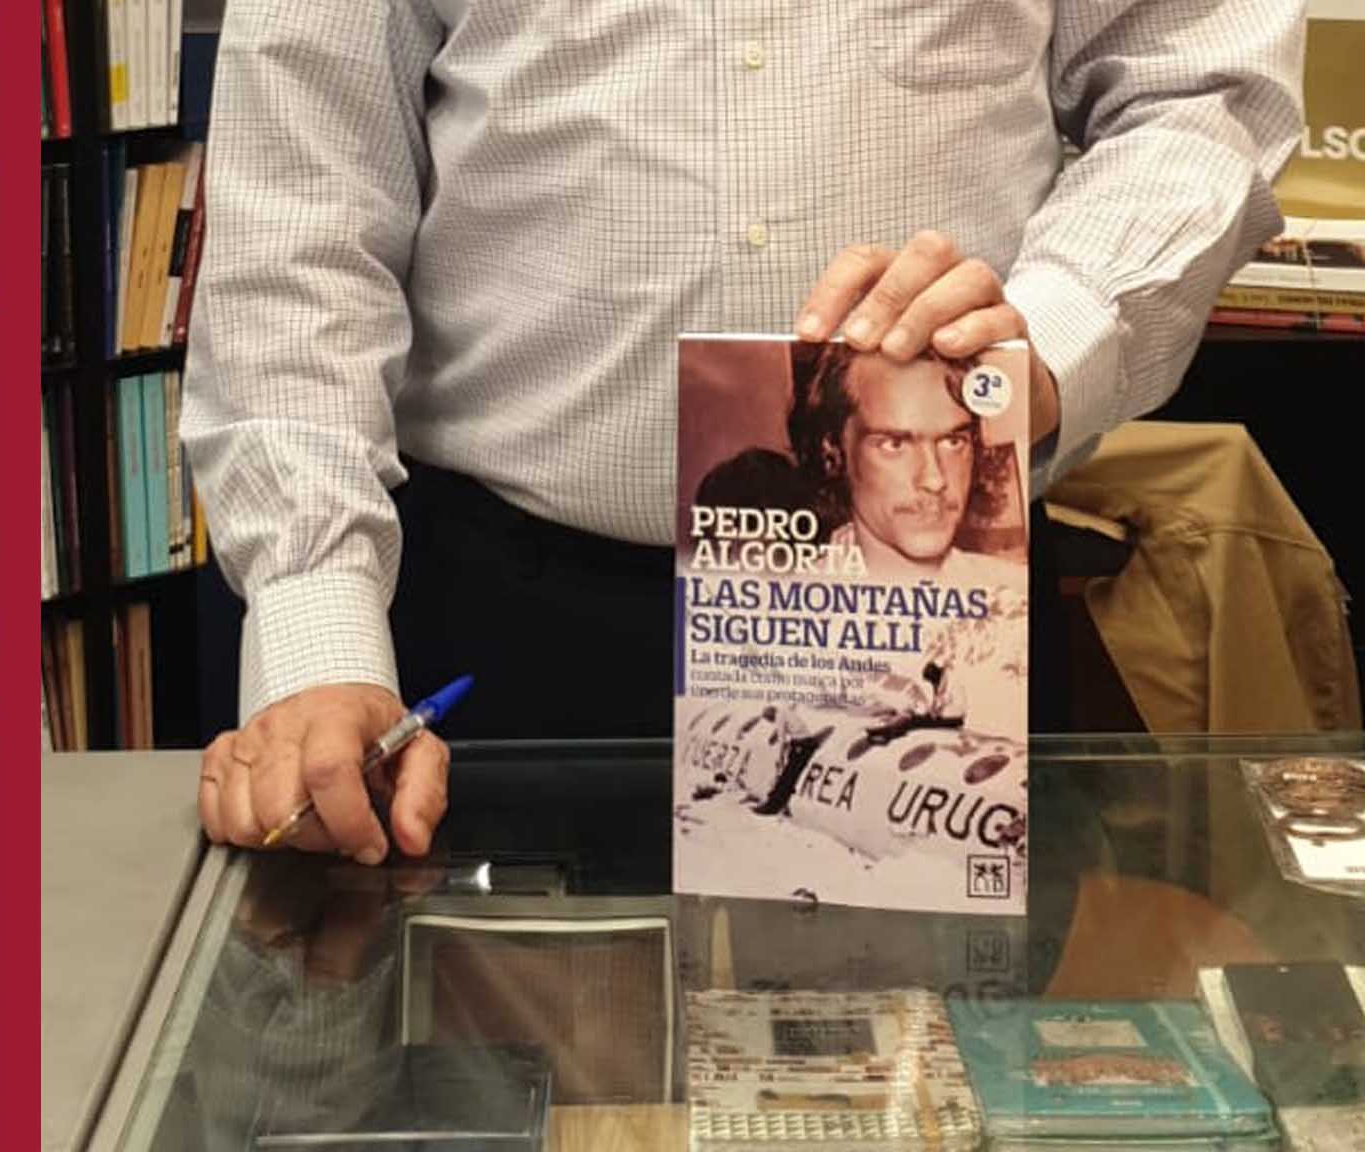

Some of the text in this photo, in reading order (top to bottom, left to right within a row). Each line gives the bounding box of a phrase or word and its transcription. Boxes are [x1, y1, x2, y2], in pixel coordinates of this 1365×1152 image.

[689, 505, 819, 541] PEDRO
[690, 540, 868, 578] ALGORTA
[690, 578, 989, 620] LAS MONTAÑAS
[689, 614, 922, 653] SIGUEN ALLÍ
[690, 649, 891, 673] La tragedia de los Andes
